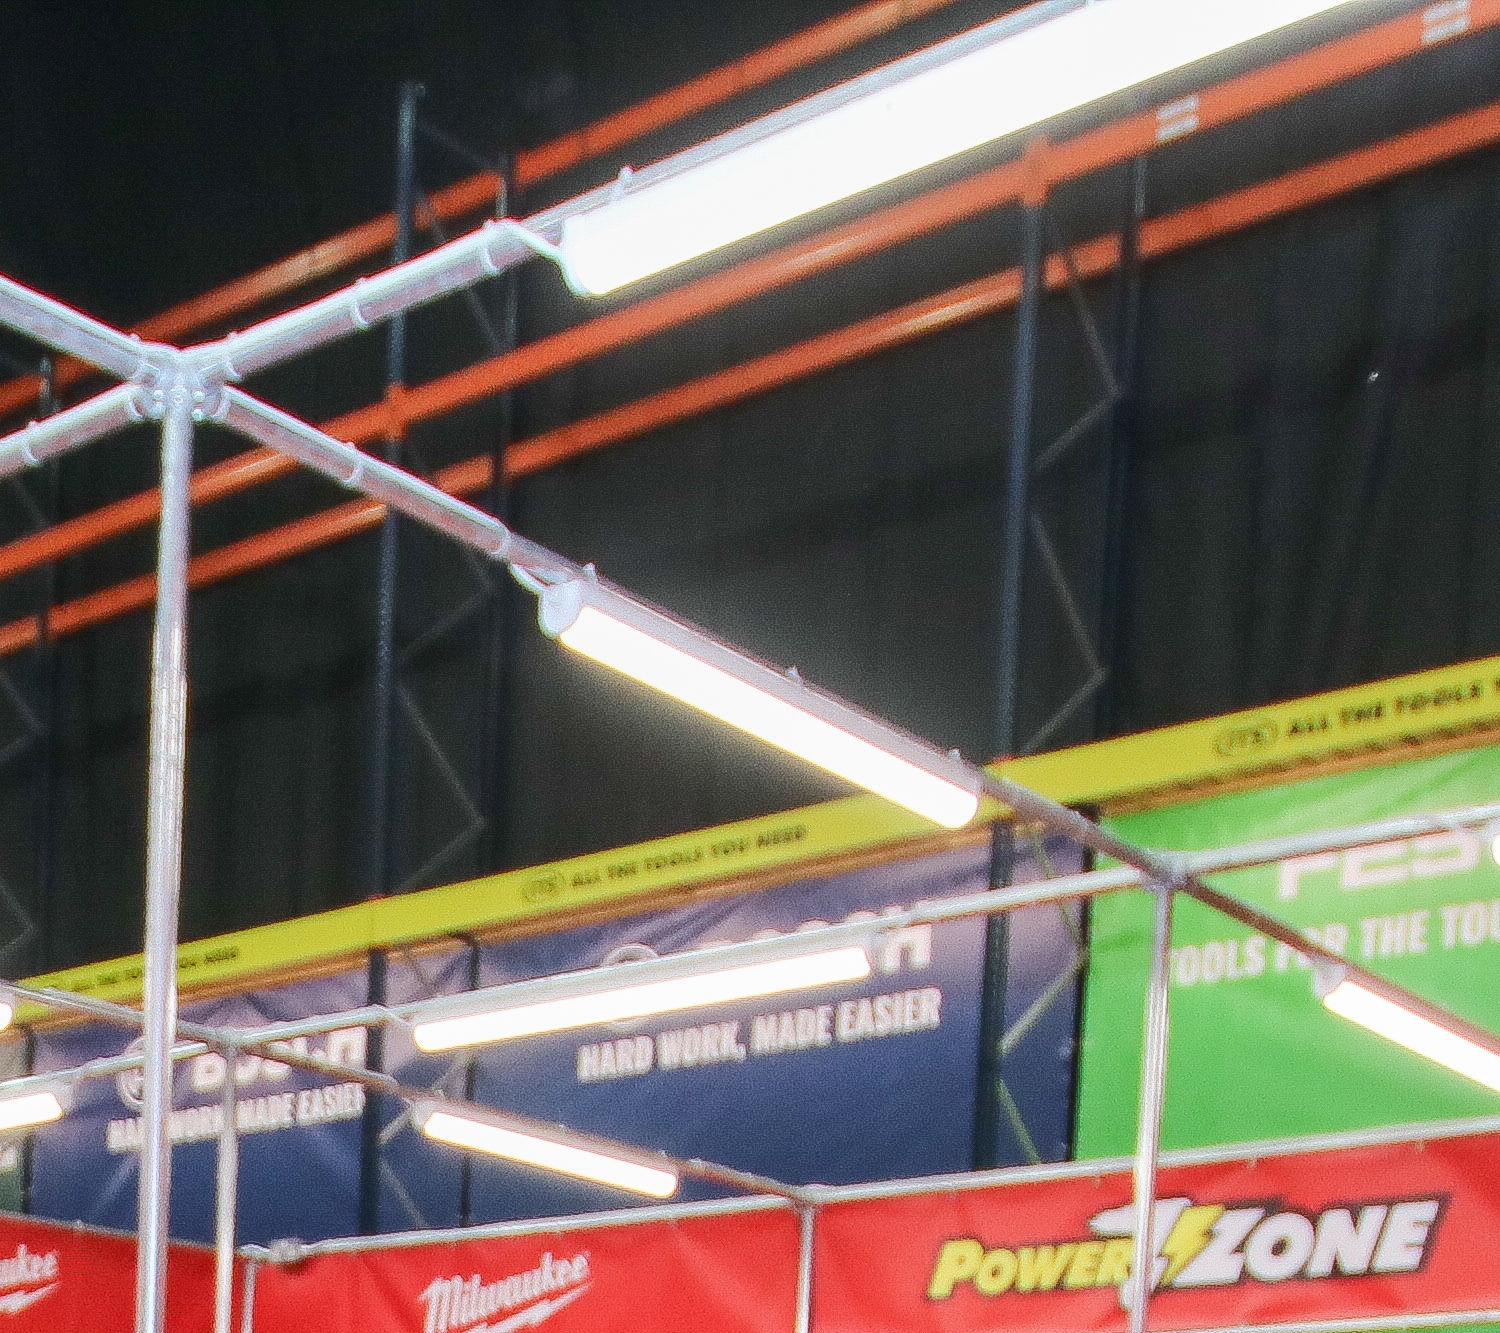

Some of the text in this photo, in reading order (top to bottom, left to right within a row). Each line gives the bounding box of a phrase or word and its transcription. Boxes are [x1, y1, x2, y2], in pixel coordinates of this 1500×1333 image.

[1359, 909, 1430, 960] THE
[576, 1034, 656, 1084] HARD
[749, 1003, 834, 1057] MADE
[834, 985, 945, 1043] EASIER
[1170, 1199, 1445, 1288] ZONE
